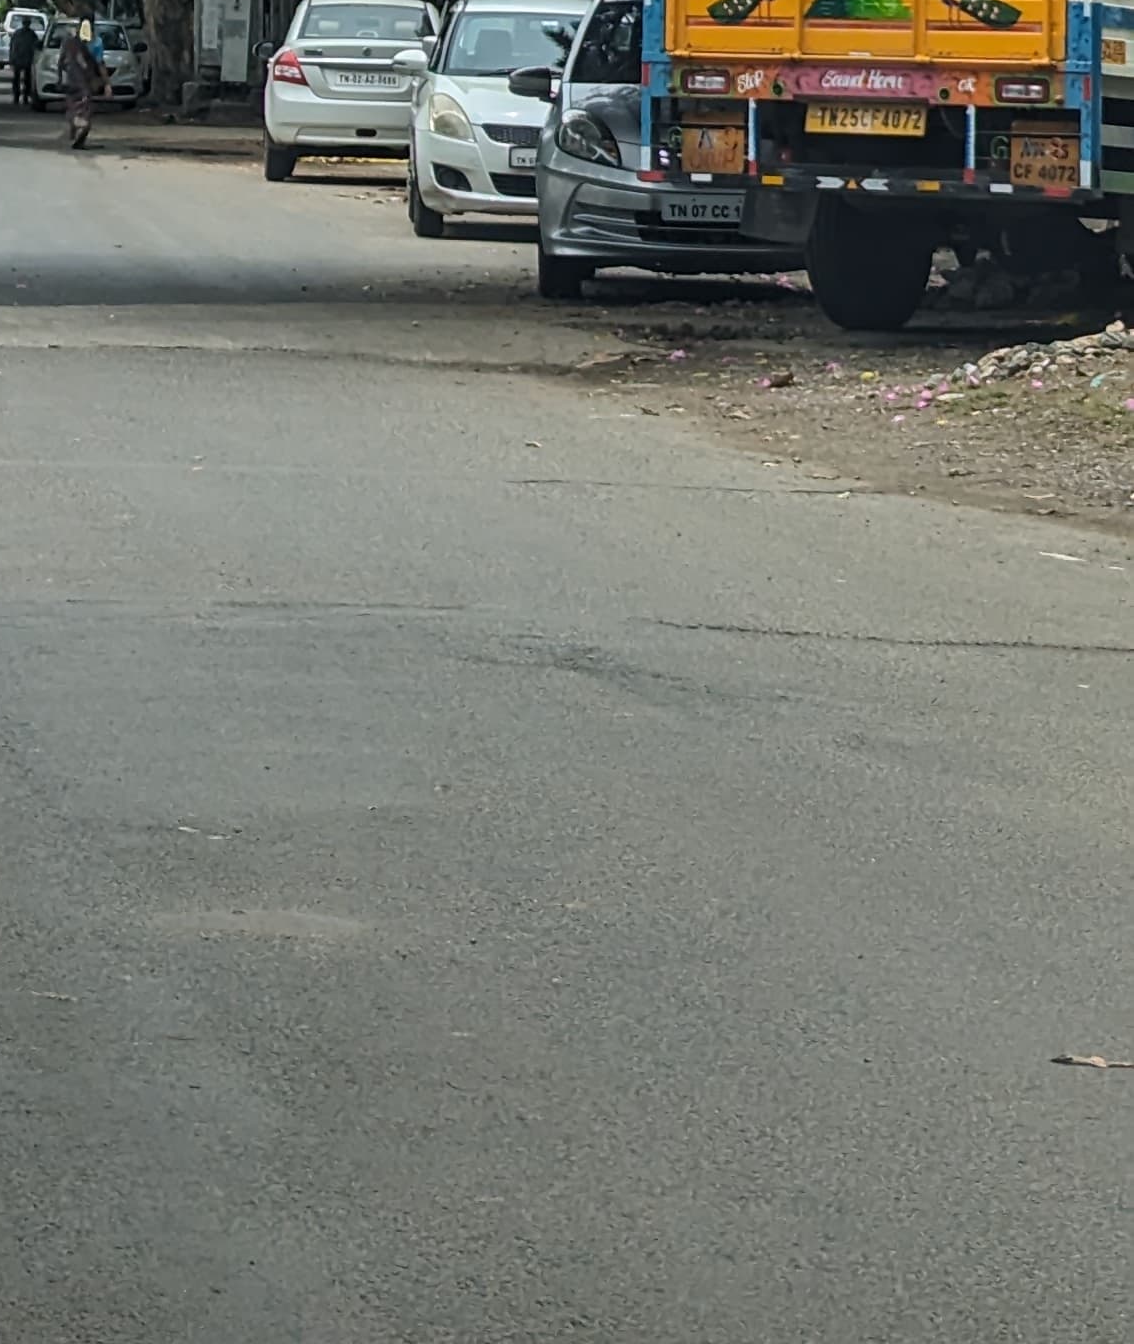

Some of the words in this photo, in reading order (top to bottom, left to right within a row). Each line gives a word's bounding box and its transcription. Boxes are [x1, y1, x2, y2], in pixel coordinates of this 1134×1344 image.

[669, 204, 688, 217] TN
[691, 204, 708, 218] 07
[711, 205, 730, 218] CC
